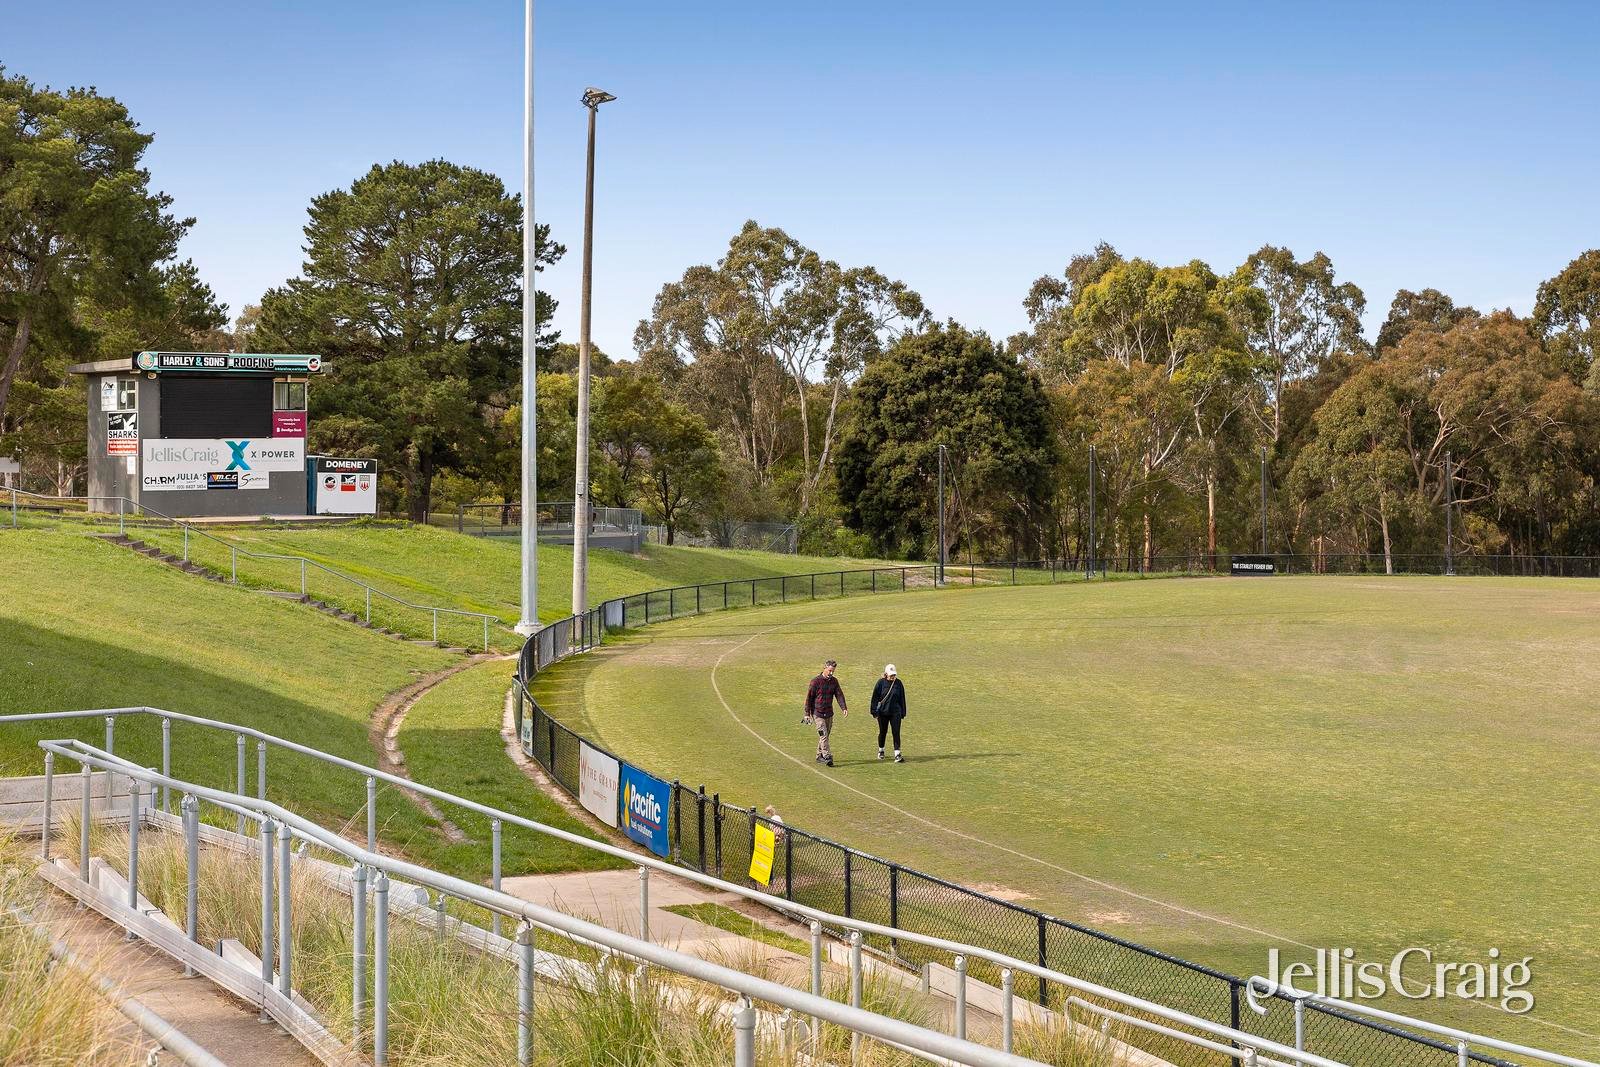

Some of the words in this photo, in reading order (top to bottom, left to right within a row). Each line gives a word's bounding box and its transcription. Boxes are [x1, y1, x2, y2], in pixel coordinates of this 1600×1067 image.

[163, 356, 194, 366] HARLEY
[195, 357, 203, 367] &
[203, 357, 225, 367] SONS
[233, 357, 274, 369] ROOFING
[108, 430, 138, 439] SHARKS
[146, 447, 219, 465] JellisCraig
[261, 450, 295, 458] POWER
[325, 460, 369, 469] DOMENEY
[176, 473, 207, 481] JULIA'S
[630, 784, 661, 824] Pacific
